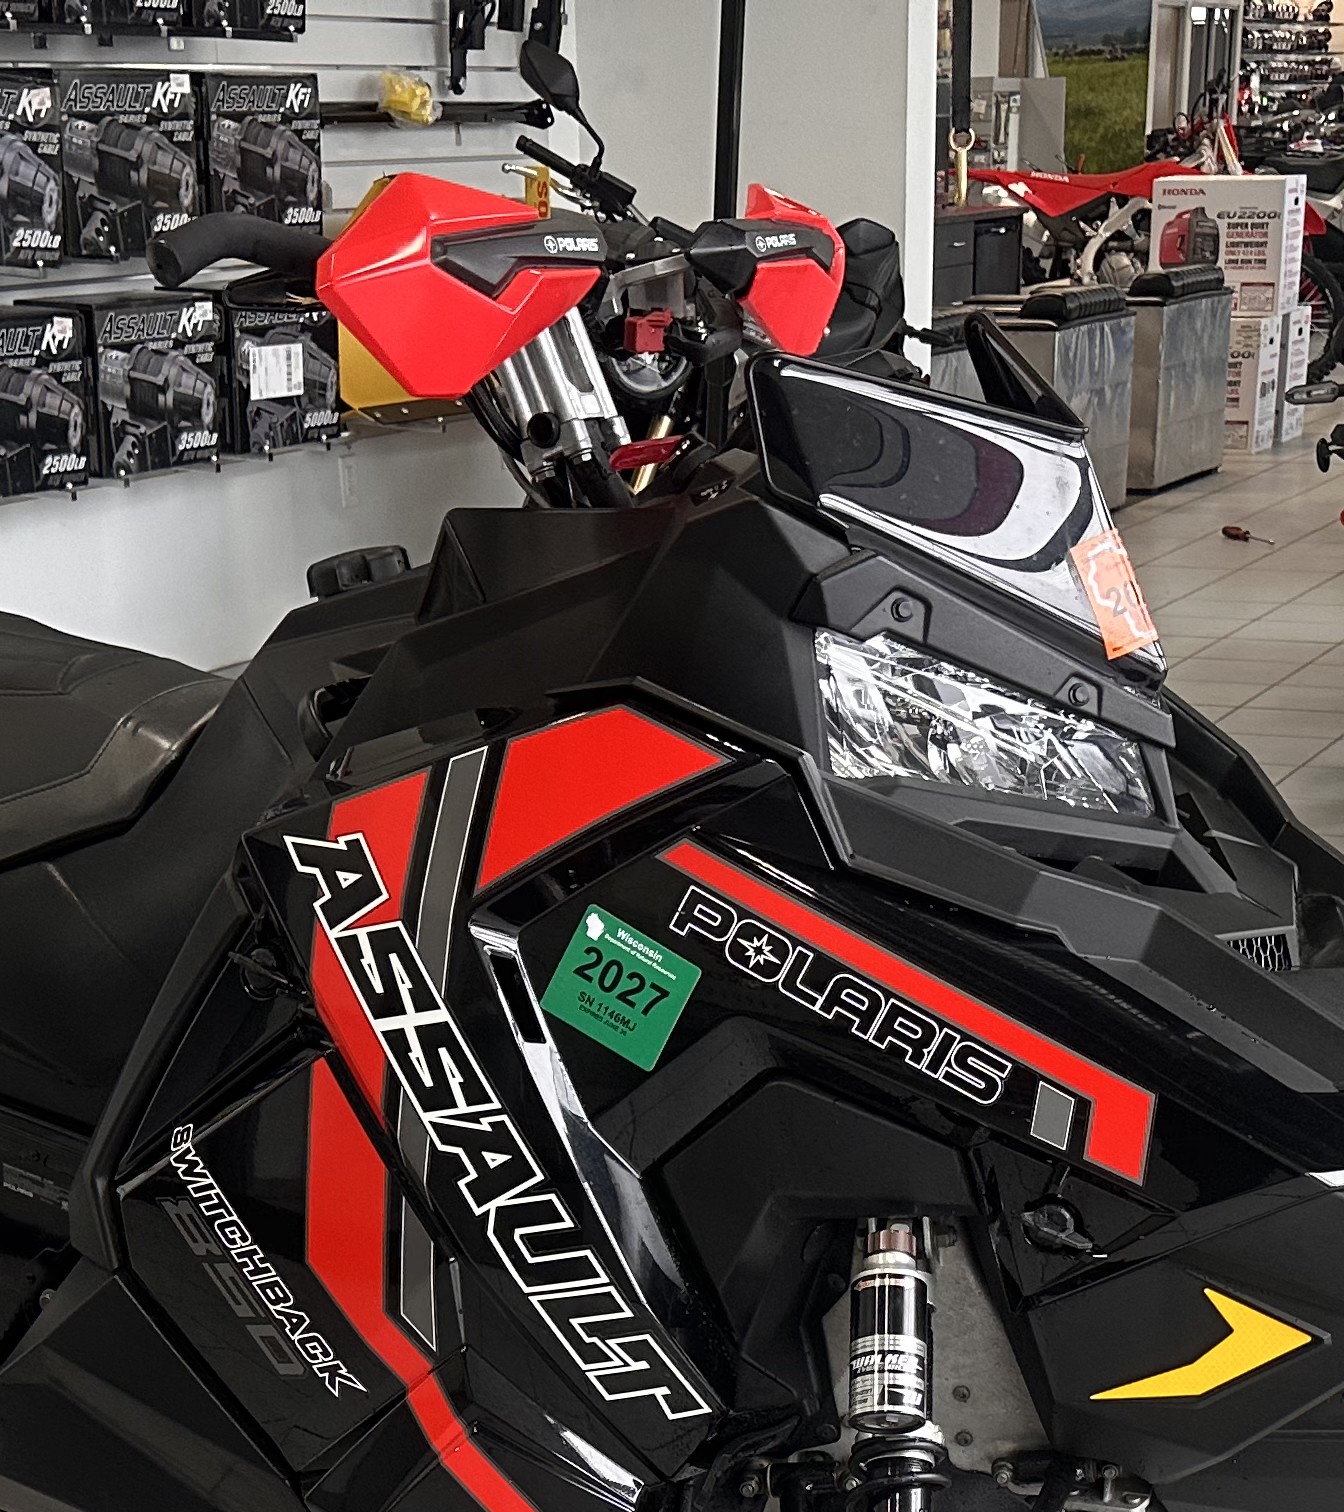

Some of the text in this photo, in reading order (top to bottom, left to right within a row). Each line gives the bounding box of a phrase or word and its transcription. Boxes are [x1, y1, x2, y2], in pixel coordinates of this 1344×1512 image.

[61, 79, 153, 111] ASSAULT
[211, 81, 287, 111] ASSAULT
[285, 83, 312, 113] KFi
[1162, 188, 1206, 196] HONDA
[12, 227, 63, 249] 2500LB
[557, 238, 599, 252] POLARIS
[98, 312, 179, 345] ASSAULT
[179, 430, 219, 451] 3500LB
[43, 453, 87, 475] 2500LB
[616, 927, 664, 963] Wisconsin
[572, 945, 671, 1017] 2027
[669, 886, 1013, 1105] POLARIS
[577, 990, 596, 1008] SN
[283, 831, 712, 1420] ASSAULT
[171, 1123, 368, 1398] SWITCHBACK
